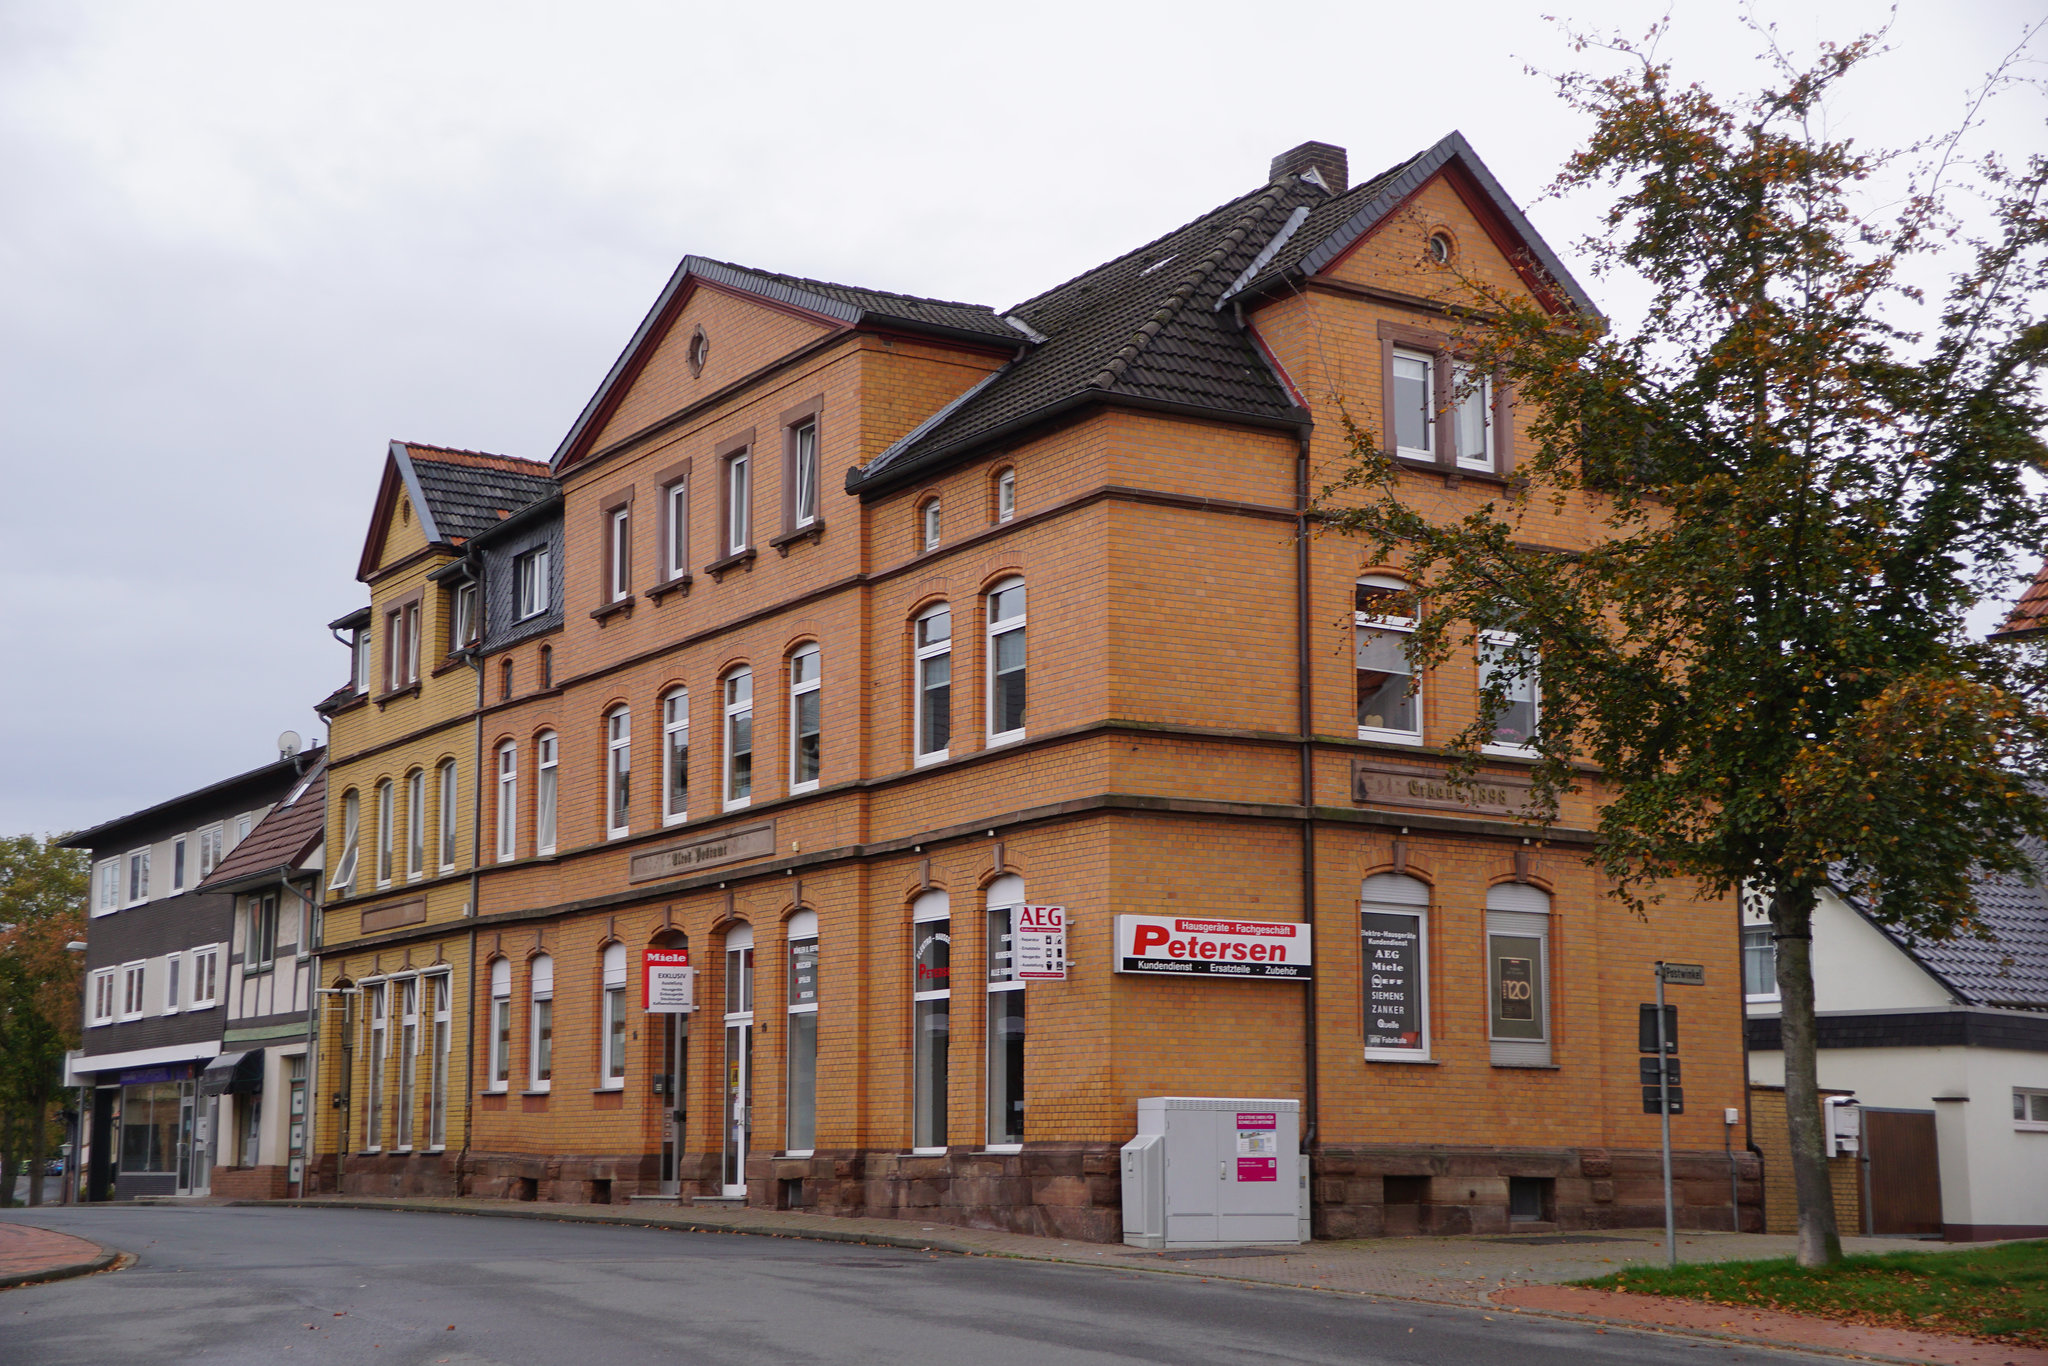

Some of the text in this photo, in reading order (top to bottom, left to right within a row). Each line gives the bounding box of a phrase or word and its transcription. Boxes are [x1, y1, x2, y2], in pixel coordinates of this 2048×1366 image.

[1471, 785, 1507, 804] 1898
[1020, 907, 1062, 926] AEG
[1182, 921, 1229, 933] Hausgeräte
[1236, 923, 1291, 935] Fachgeschäft
[1133, 924, 1287, 962] Petersen
[1368, 938, 1408, 946] Kundendienst
[647, 953, 687, 962] Miele
[1375, 949, 1400, 959] AEG
[1138, 960, 1298, 976] Kundendienst Ersatzteile Zubehör
[1372, 962, 1404, 971] Miele
[1665, 966, 1702, 980] Postwinkel
[1507, 980, 1530, 1000] 120
[1371, 991, 1405, 1000] SIEMENS
[1372, 1004, 1405, 1014] ZANKER
[1377, 1018, 1399, 1028] Quelle
[1382, 1036, 1407, 1044] Fabrikate
